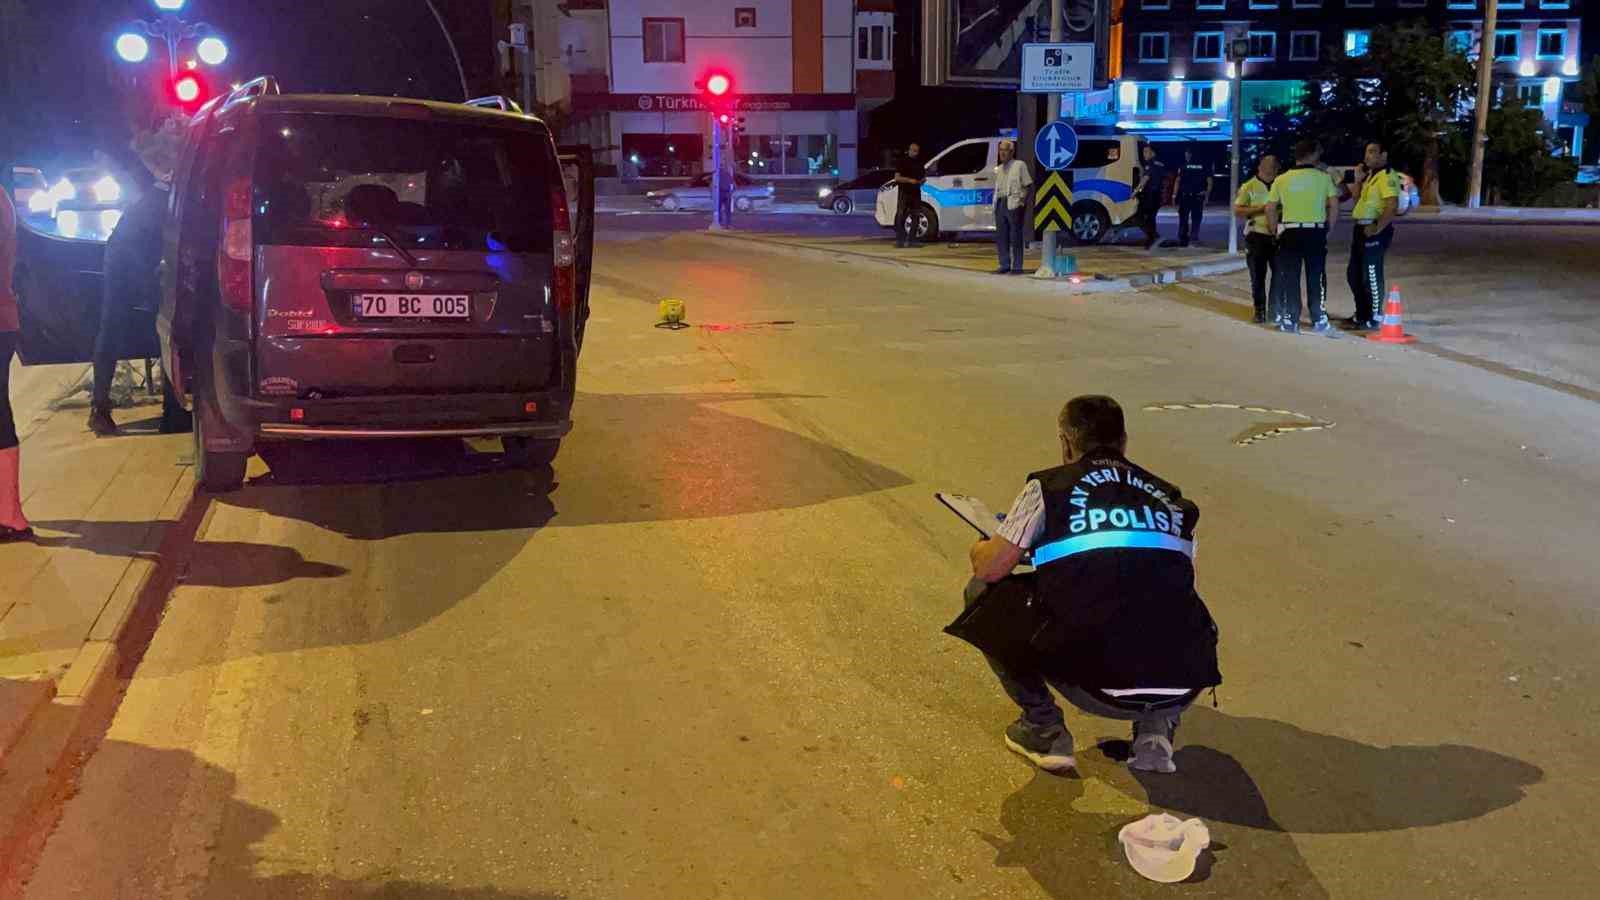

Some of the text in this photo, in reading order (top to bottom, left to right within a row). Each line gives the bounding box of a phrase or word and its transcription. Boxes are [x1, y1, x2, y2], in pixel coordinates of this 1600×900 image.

[363, 296, 467, 314] 70 BC 005
[1069, 486, 1090, 533] OLAY
